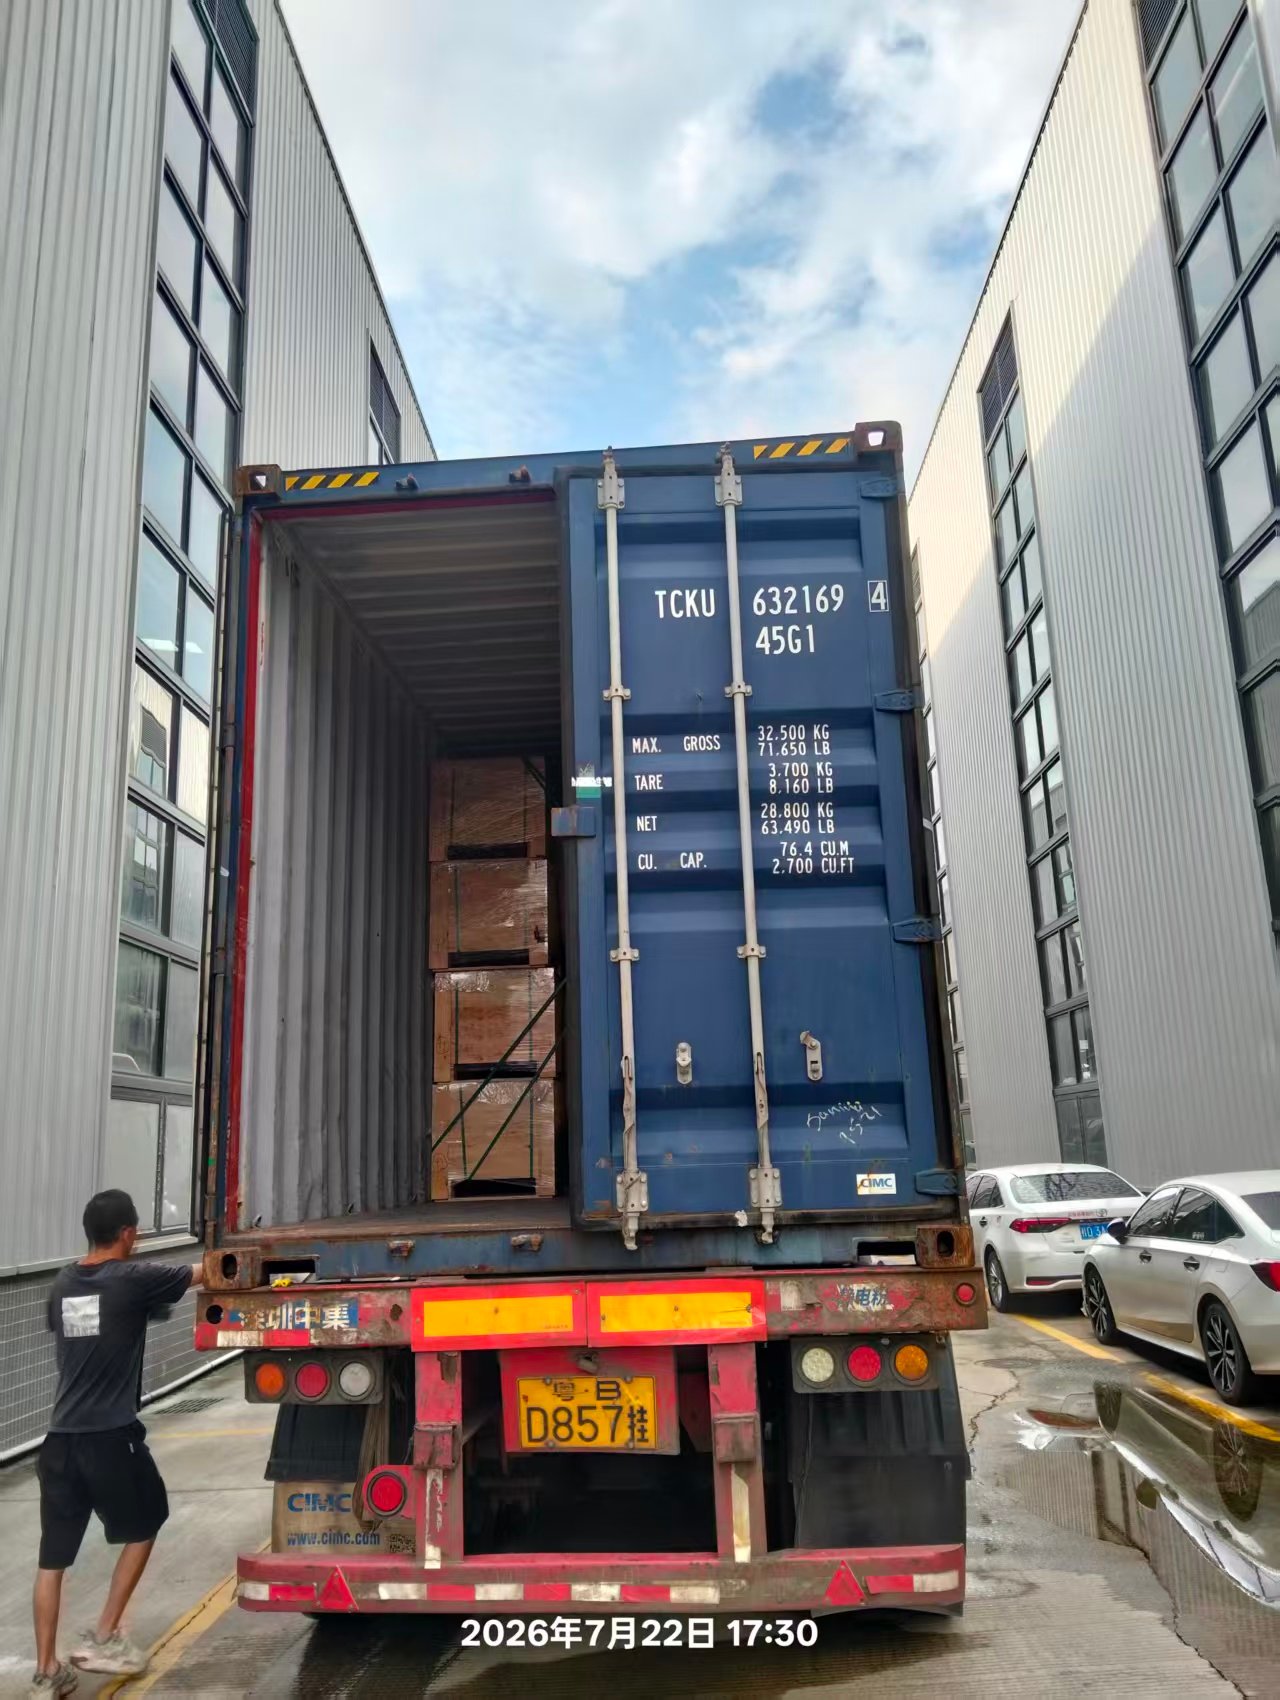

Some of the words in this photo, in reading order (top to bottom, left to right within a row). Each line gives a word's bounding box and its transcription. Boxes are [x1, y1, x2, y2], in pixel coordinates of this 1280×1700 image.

[655, 588, 716, 619] TCKU
[752, 583, 844, 616] 632169
[871, 581, 888, 611] 4
[755, 624, 816, 655] 45G1
[813, 724, 830, 740] KG
[632, 737, 662, 753] MAX.
[683, 735, 721, 751] GROSS
[814, 741, 831, 756] LB
[816, 761, 833, 777] KG
[634, 774, 664, 791] TARE
[817, 777, 834, 794] LB
[817, 801, 834, 818] KG
[636, 815, 658, 832] NET
[818, 819, 835, 834] LB
[780, 841, 813, 857] 76.4
[820, 840, 850, 856] CU.M
[637, 853, 658, 870] CU.
[680, 852, 708, 869] CAP.
[821, 857, 855, 874] CU.FT
[860, 1178, 893, 1188] CIMC
[287, 1493, 352, 1513] CIMC
[287, 1530, 381, 1546] www.cimc.com
